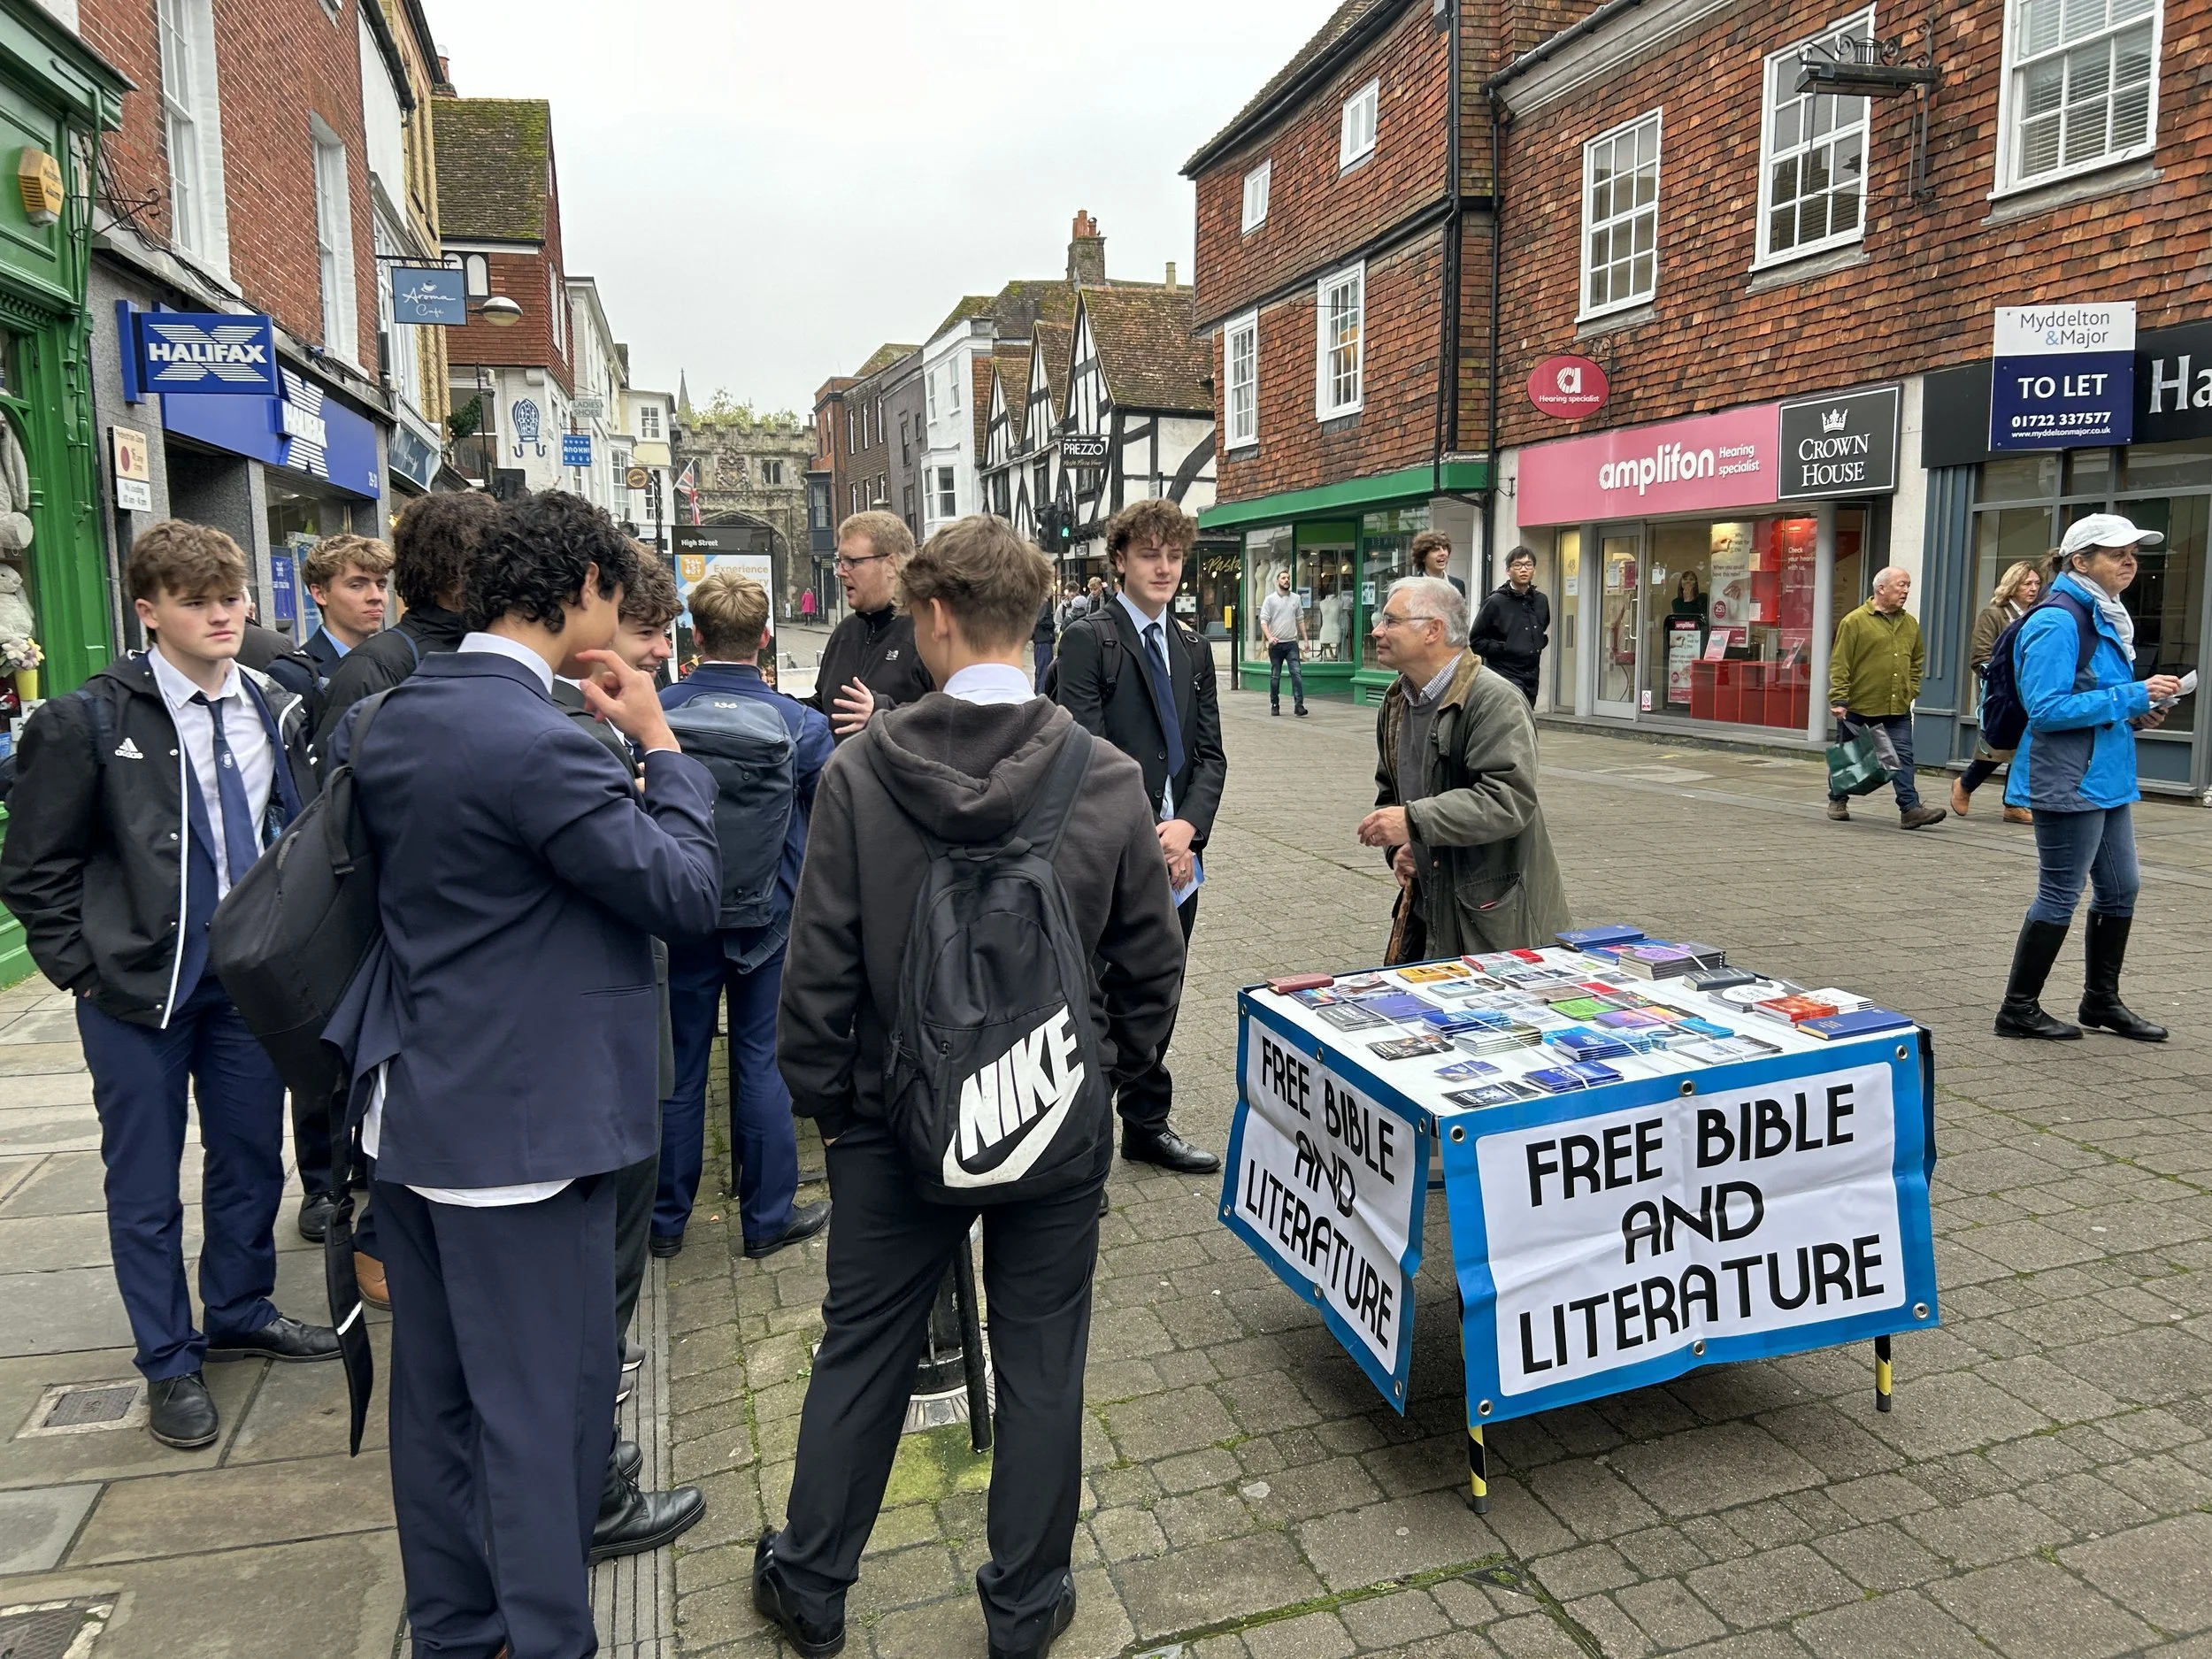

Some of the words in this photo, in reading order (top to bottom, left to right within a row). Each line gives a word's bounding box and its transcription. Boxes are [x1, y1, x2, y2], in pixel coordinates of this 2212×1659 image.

[402, 288, 457, 303] Aroma
[2020, 310, 2110, 332] Myddelton
[2045, 327, 2109, 349] &Major
[148, 342, 268, 364] HALIFAX
[2017, 376, 2056, 399] TO
[2063, 373, 2109, 397] LET
[572, 400, 600, 409] LADIES
[1539, 395, 1567, 404] Hearing
[1568, 395, 1600, 403] specialist
[282, 400, 327, 449] HALIFAX
[2011, 414, 2055, 427] 01722
[2059, 411, 2112, 426] 337577
[2011, 426, 2112, 439] www.myddeltonmajor.co.uk
[1064, 443, 1103, 456] PREZZO
[1718, 443, 1755, 459] Hearing
[1798, 434, 1871, 462] CROWN
[1599, 441, 1715, 495] amplifon
[1718, 460, 1760, 477] specialist
[1801, 461, 1866, 488] HOUSE
[681, 539, 697, 548] High
[713, 565, 769, 574] Experience
[1208, 556, 1241, 573] Pasta
[959, 1005, 1085, 1162] NIKE
[1261, 1034, 1311, 1120] FREE
[1324, 1077, 1395, 1186] BIBLE
[1525, 1117, 1663, 1208] FREE
[1696, 1082, 1855, 1170] BIBLE
[1294, 1130, 1356, 1219] AND
[1621, 1180, 1764, 1265] AND
[1245, 1158, 1394, 1352] LITERATURE
[1519, 1233, 1885, 1376] LITERATURE
